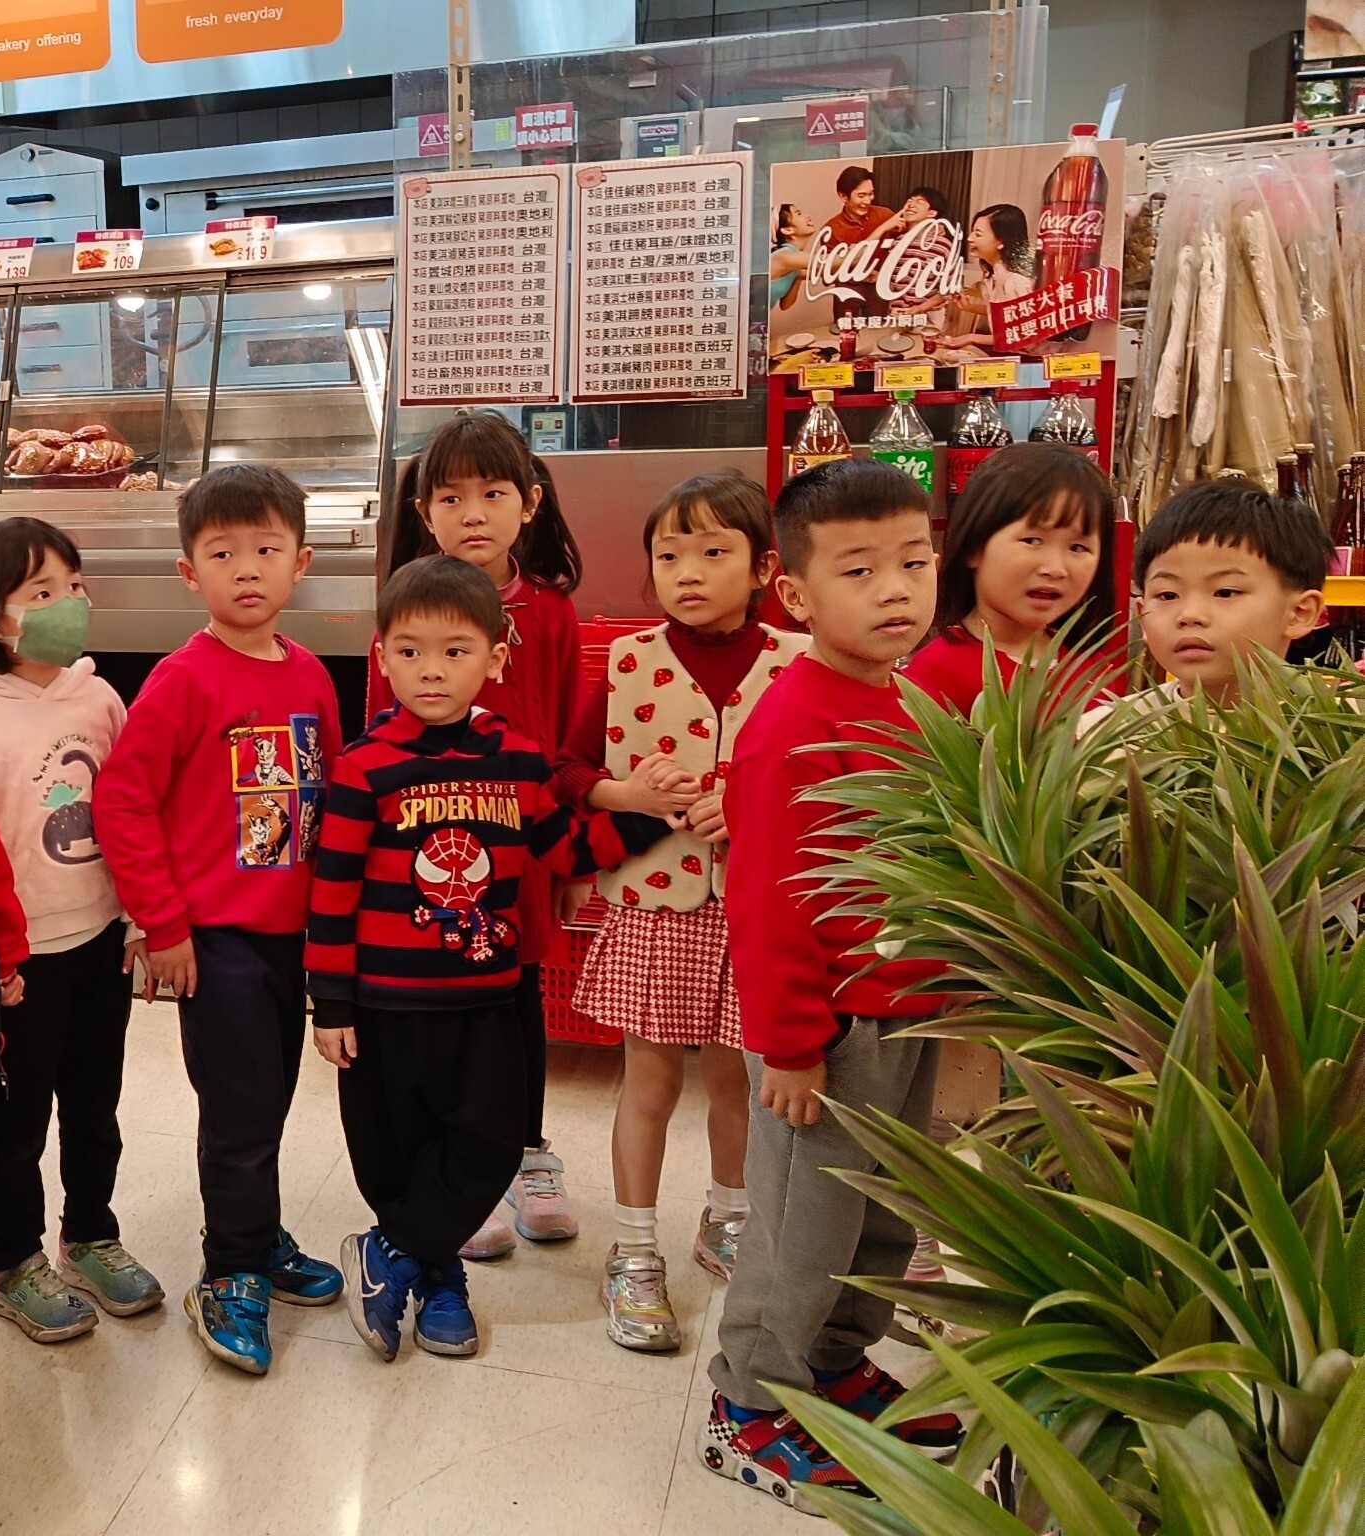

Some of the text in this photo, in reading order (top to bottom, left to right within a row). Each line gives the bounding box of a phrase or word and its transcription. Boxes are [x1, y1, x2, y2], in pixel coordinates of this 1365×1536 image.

[186, 6, 284, 28] fresh everyday
[36, 32, 82, 47] offering
[704, 178, 730, 191] 台灣
[704, 196, 730, 209] 台灣
[516, 207, 553, 221] 奧地利
[704, 214, 729, 227] 台灣
[1038, 209, 1104, 236] Coca-Col
[516, 225, 552, 239] 奧地利
[522, 243, 546, 255] 台灣
[112, 255, 134, 270] 109
[522, 261, 546, 272] 台灣
[806, 218, 963, 302] Coca-Cola
[6, 266, 26, 279] 139
[521, 278, 545, 290] 台灣
[702, 286, 728, 299] 台灣
[521, 295, 545, 306] 台灣
[702, 304, 727, 316] 台灣
[521, 313, 544, 324] 台灣
[837, 313, 927, 330] 暢享魔力瞬間
[701, 322, 726, 334] 台灣
[695, 340, 733, 352] 西班牙
[520, 347, 543, 359] 台灣
[701, 357, 726, 369] 台灣
[520, 381, 543, 393] 台灣
[694, 375, 732, 387] 西班牙
[893, 455, 927, 480] ite
[401, 782, 517, 798] SPIDER SENSE
[396, 795, 521, 831] SPIDER MAN
